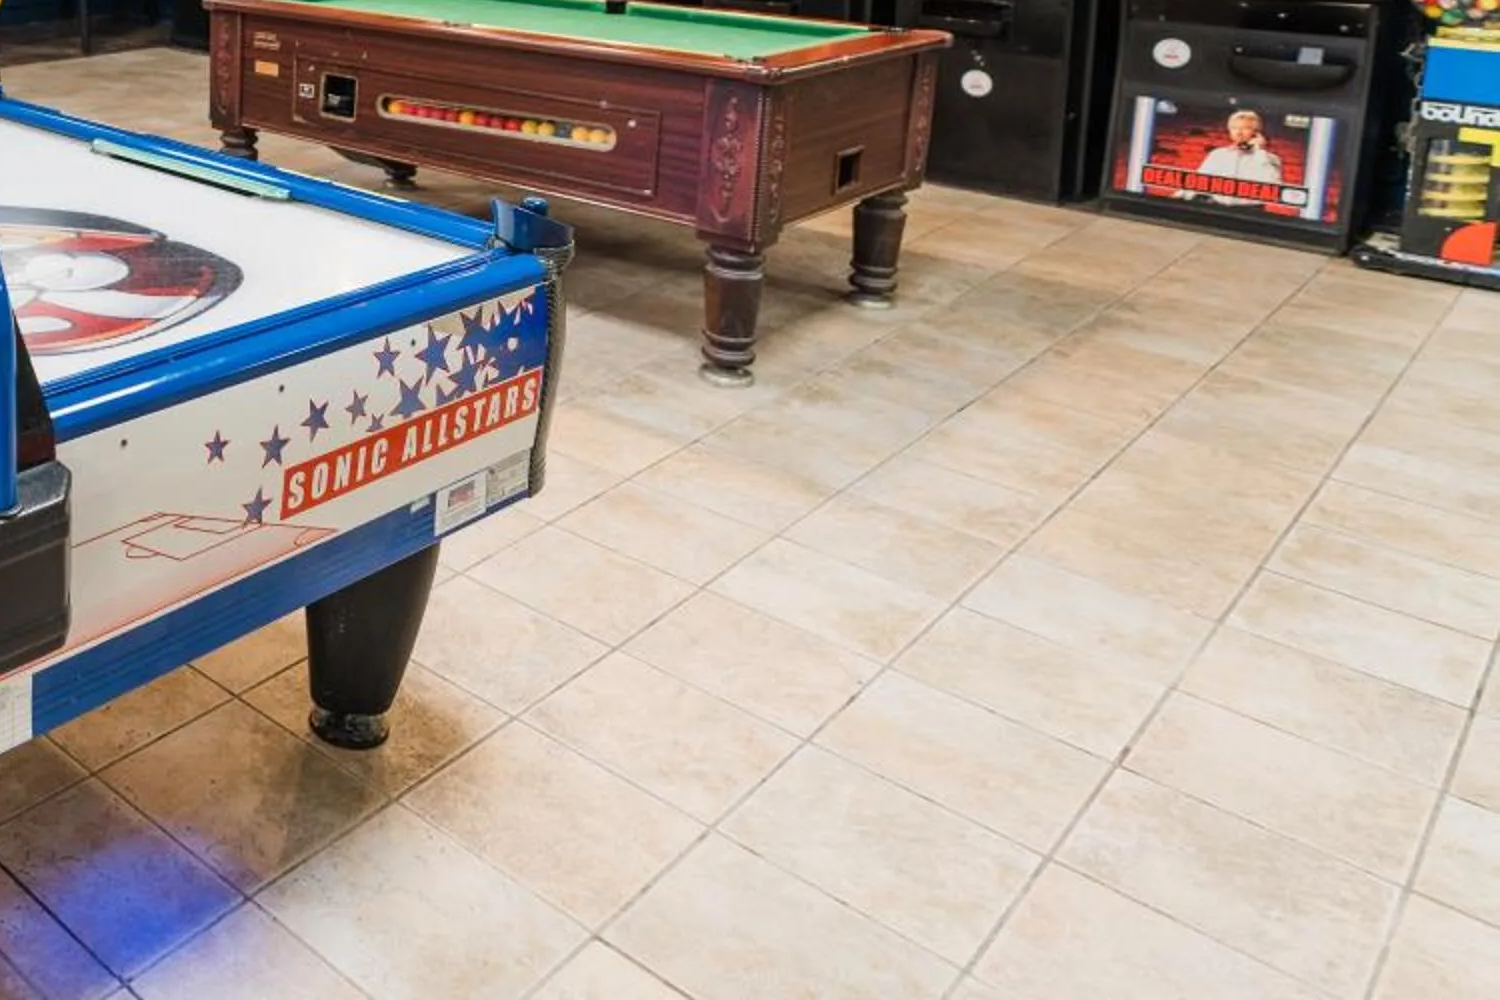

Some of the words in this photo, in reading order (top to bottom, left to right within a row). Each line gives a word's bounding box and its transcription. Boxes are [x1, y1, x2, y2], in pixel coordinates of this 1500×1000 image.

[1143, 168, 1182, 187] DEAL
[1184, 174, 1209, 191] OR
[1211, 178, 1236, 196] NO
[1238, 184, 1280, 202] DEAL
[287, 437, 388, 509] SONIC
[401, 377, 538, 462] ALLSTARS
